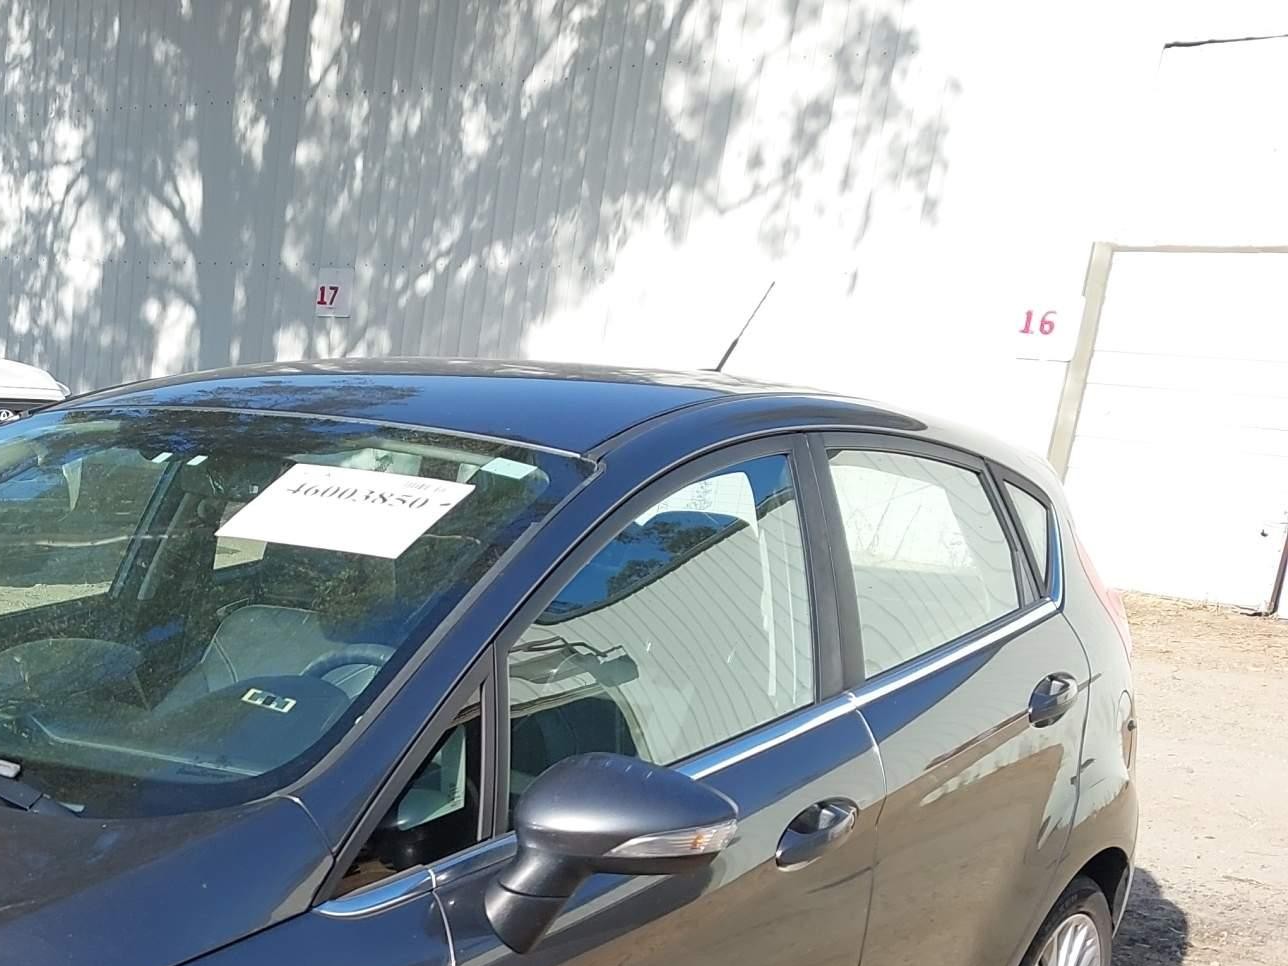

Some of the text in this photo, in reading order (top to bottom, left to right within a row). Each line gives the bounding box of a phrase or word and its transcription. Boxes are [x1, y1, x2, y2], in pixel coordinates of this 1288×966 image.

[316, 286, 340, 306] 17
[1018, 309, 1057, 335] 16
[286, 483, 430, 510] 46003850
